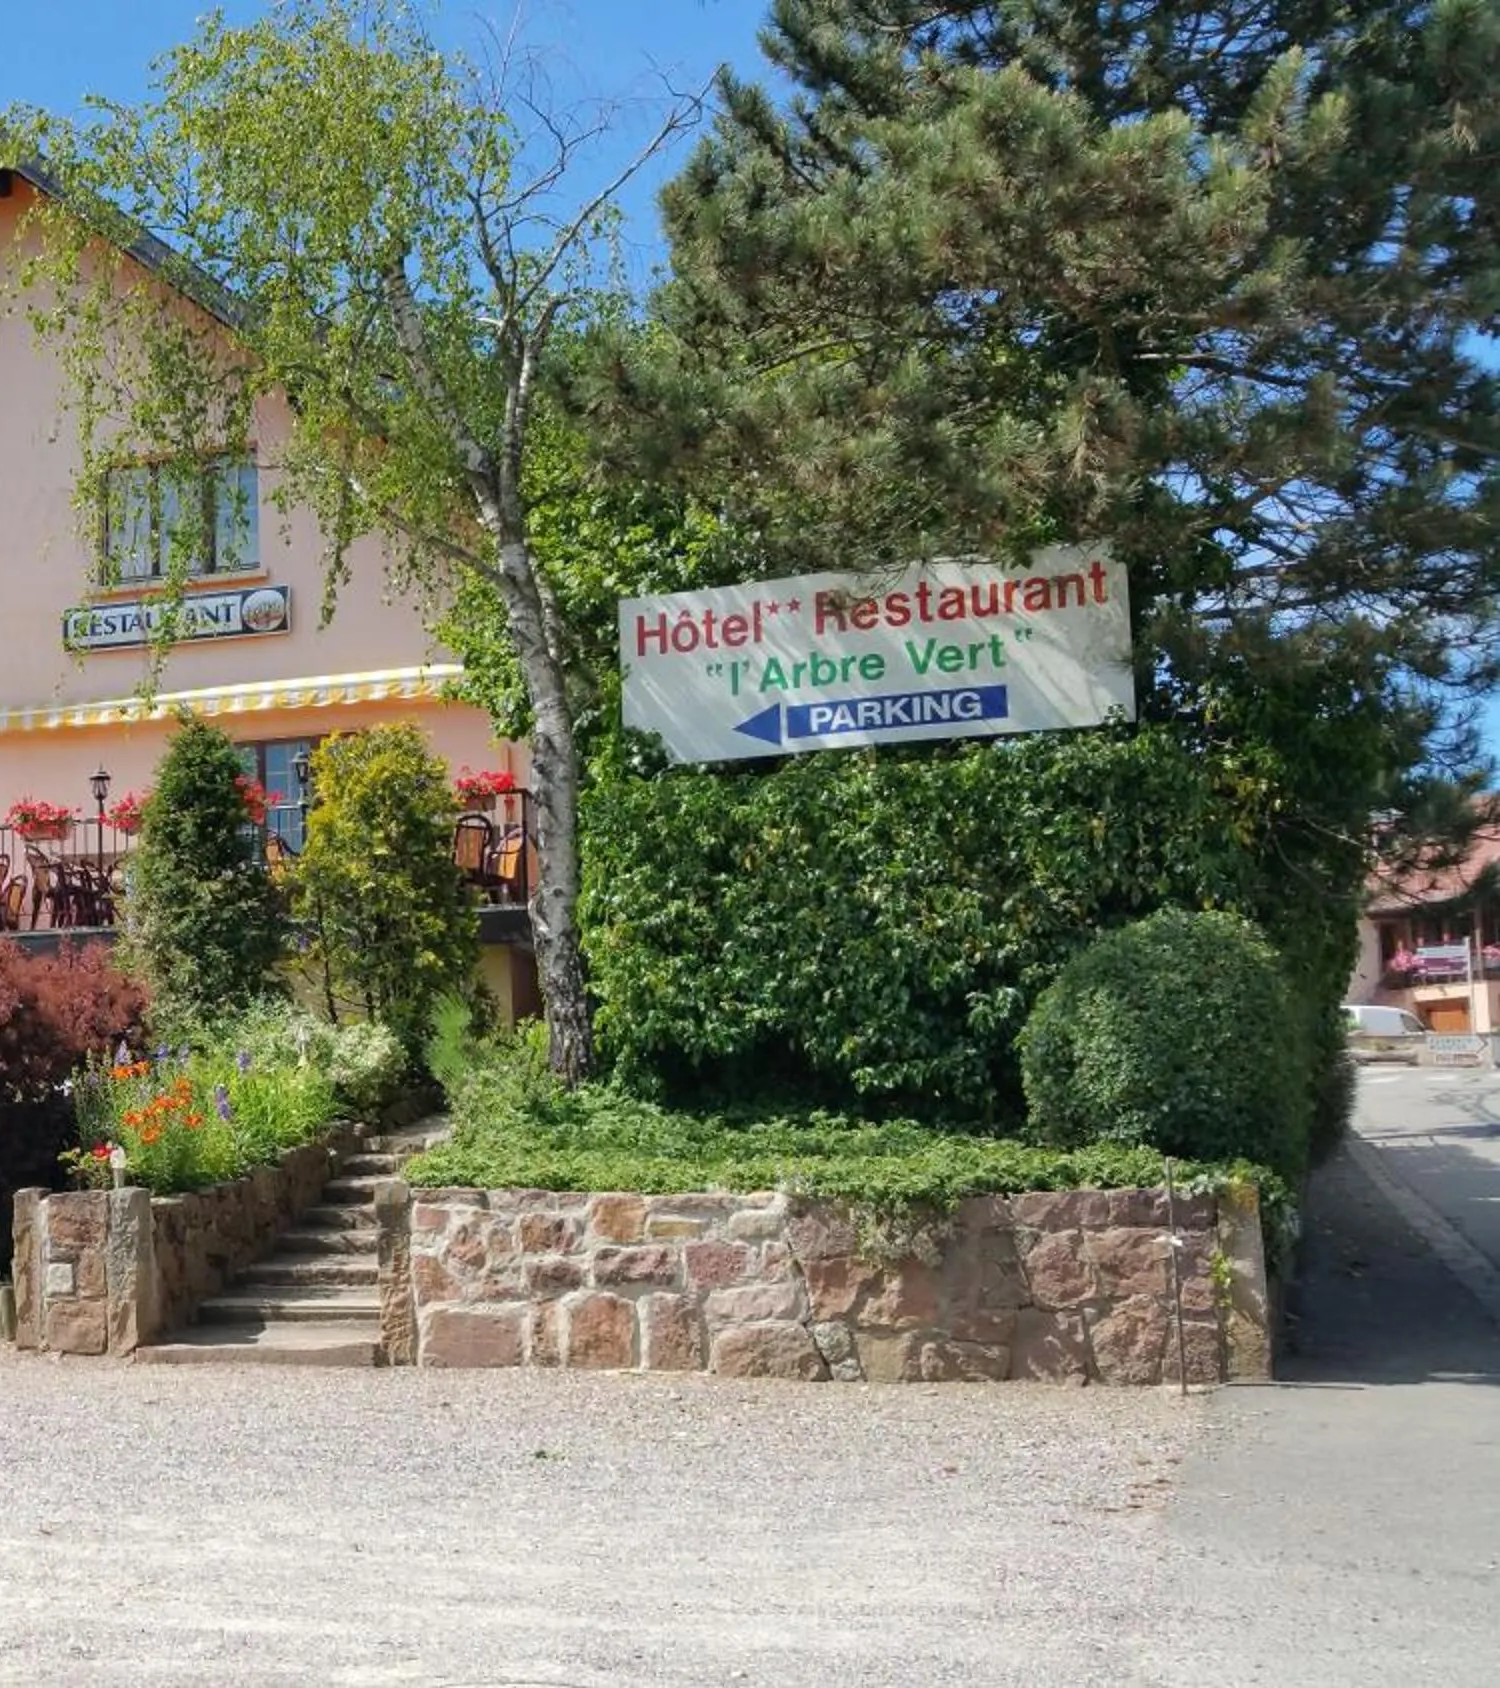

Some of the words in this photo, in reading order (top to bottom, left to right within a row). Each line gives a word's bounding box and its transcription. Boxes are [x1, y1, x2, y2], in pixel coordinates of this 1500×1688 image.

[73, 602, 236, 637] ESTAANT
[636, 600, 764, 657] Hôtel
[815, 561, 1109, 635] Restaurant
[809, 691, 983, 733] PARKING
